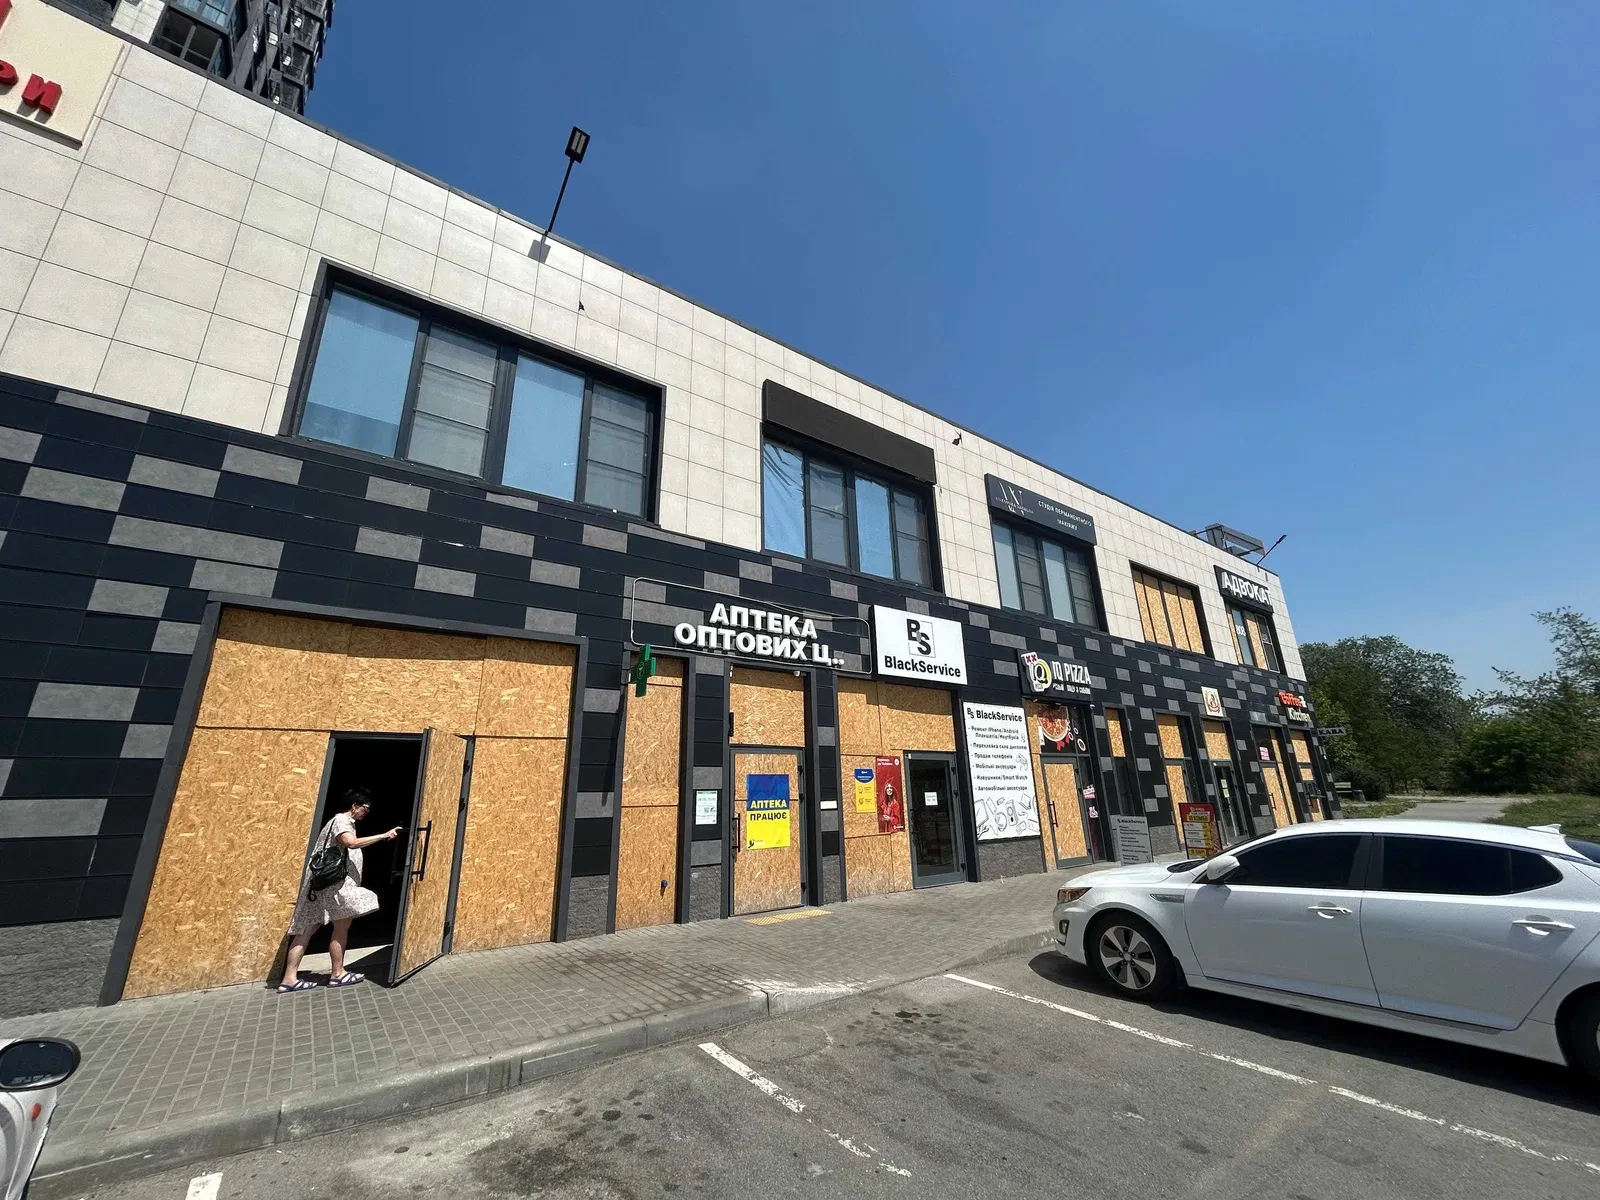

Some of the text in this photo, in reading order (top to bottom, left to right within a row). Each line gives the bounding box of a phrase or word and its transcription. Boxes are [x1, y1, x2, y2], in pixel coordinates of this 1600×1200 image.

[1222, 572, 1273, 606] АДВОКАТ
[709, 603, 818, 640] АПТЕКА
[674, 623, 808, 661] ОПТОВИХ
[884, 655, 961, 677] BlackService
[1063, 663, 1092, 684] PIZZA
[976, 709, 1023, 722] BlackService
[750, 799, 788, 810] АПТЕКА
[750, 812, 788, 822] ПРАЦЮЄ
